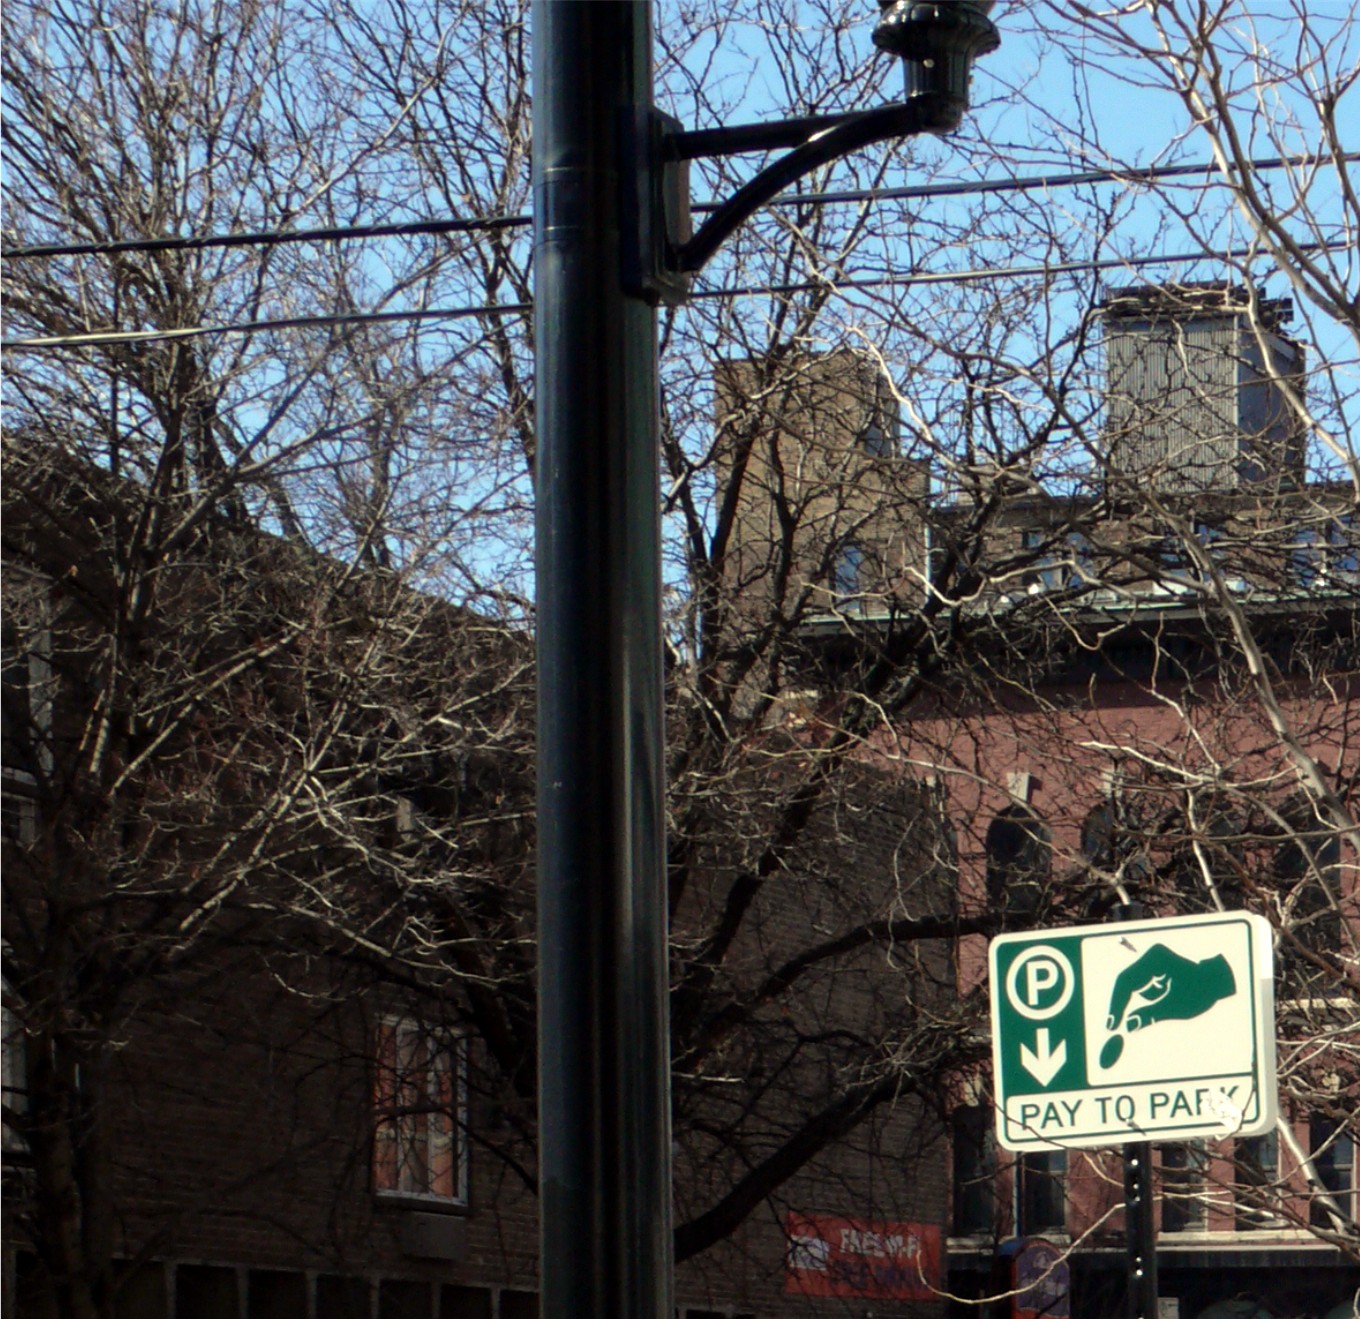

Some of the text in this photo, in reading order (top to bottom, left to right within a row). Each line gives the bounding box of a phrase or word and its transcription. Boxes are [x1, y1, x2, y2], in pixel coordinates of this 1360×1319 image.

[1026, 960, 1059, 1006] P
[1020, 1099, 1083, 1131] PAY
[1095, 1094, 1136, 1125] TO
